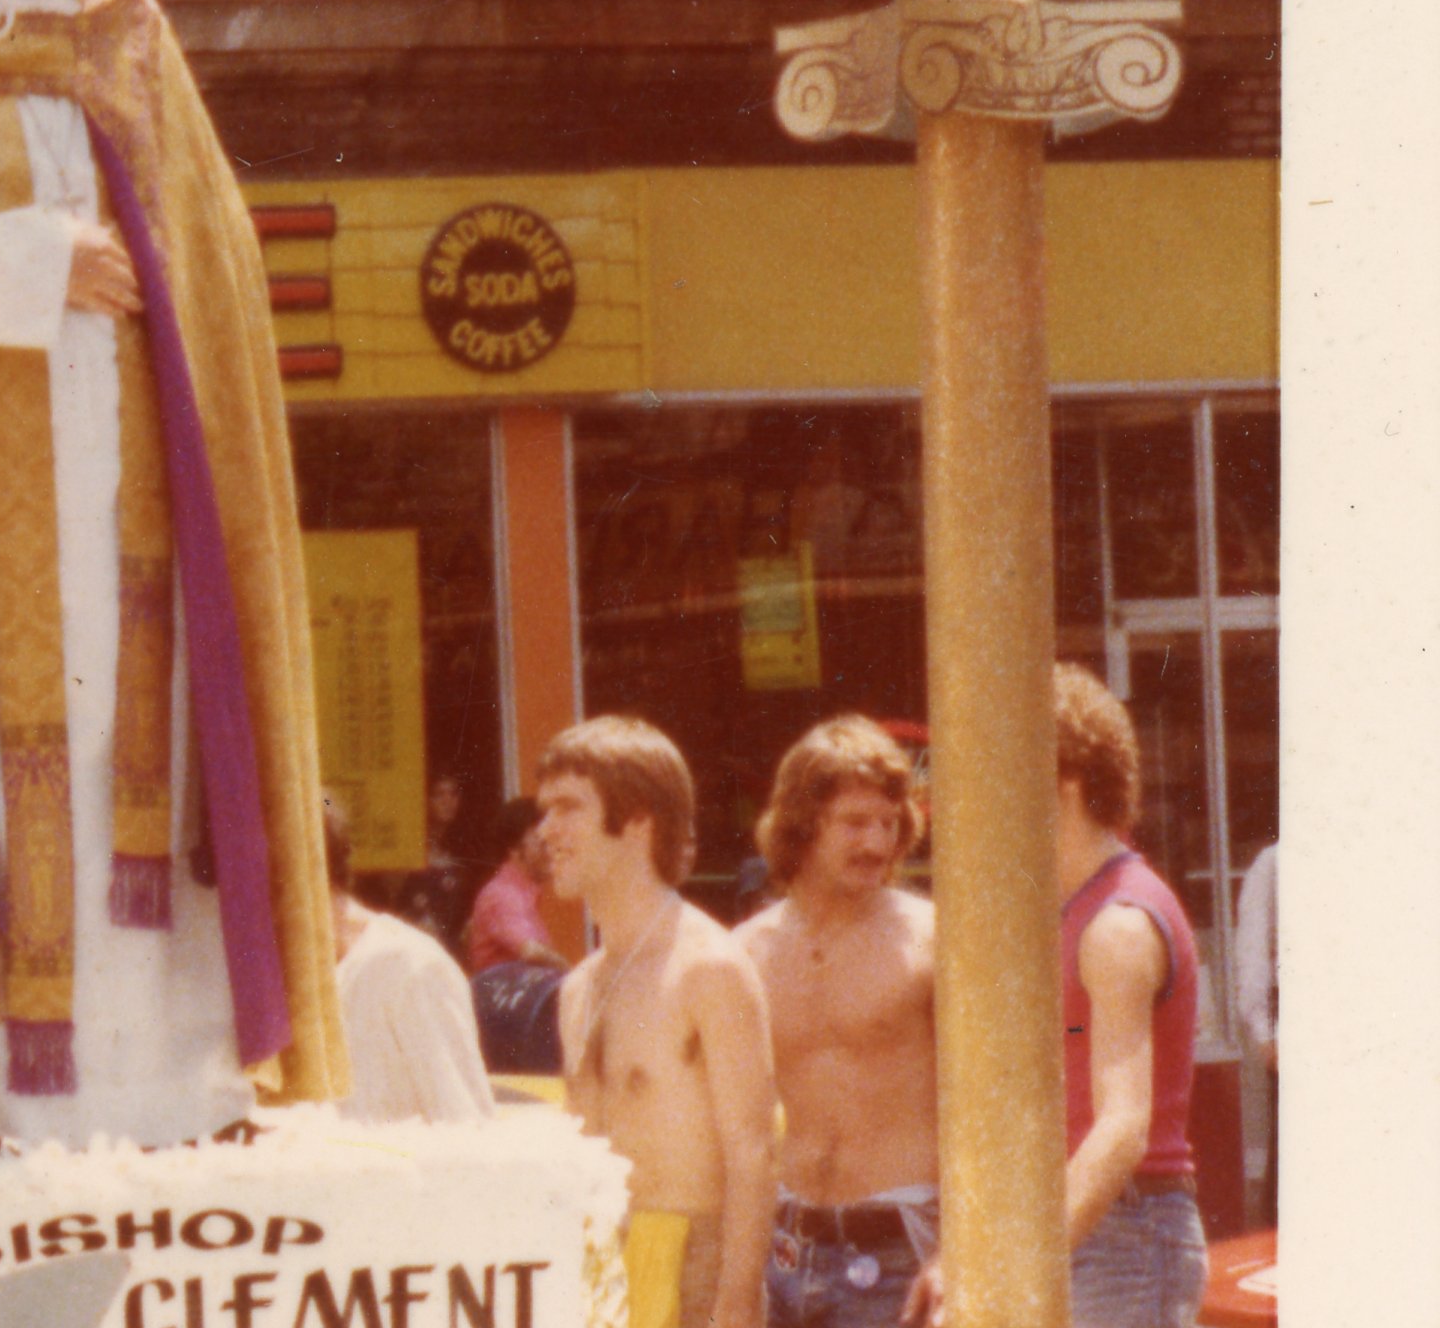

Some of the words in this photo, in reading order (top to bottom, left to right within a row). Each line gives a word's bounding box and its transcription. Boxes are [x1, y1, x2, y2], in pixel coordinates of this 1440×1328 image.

[428, 208, 571, 297] SANDWICHES
[464, 272, 539, 307] SODA
[448, 317, 552, 366] COFFEE
